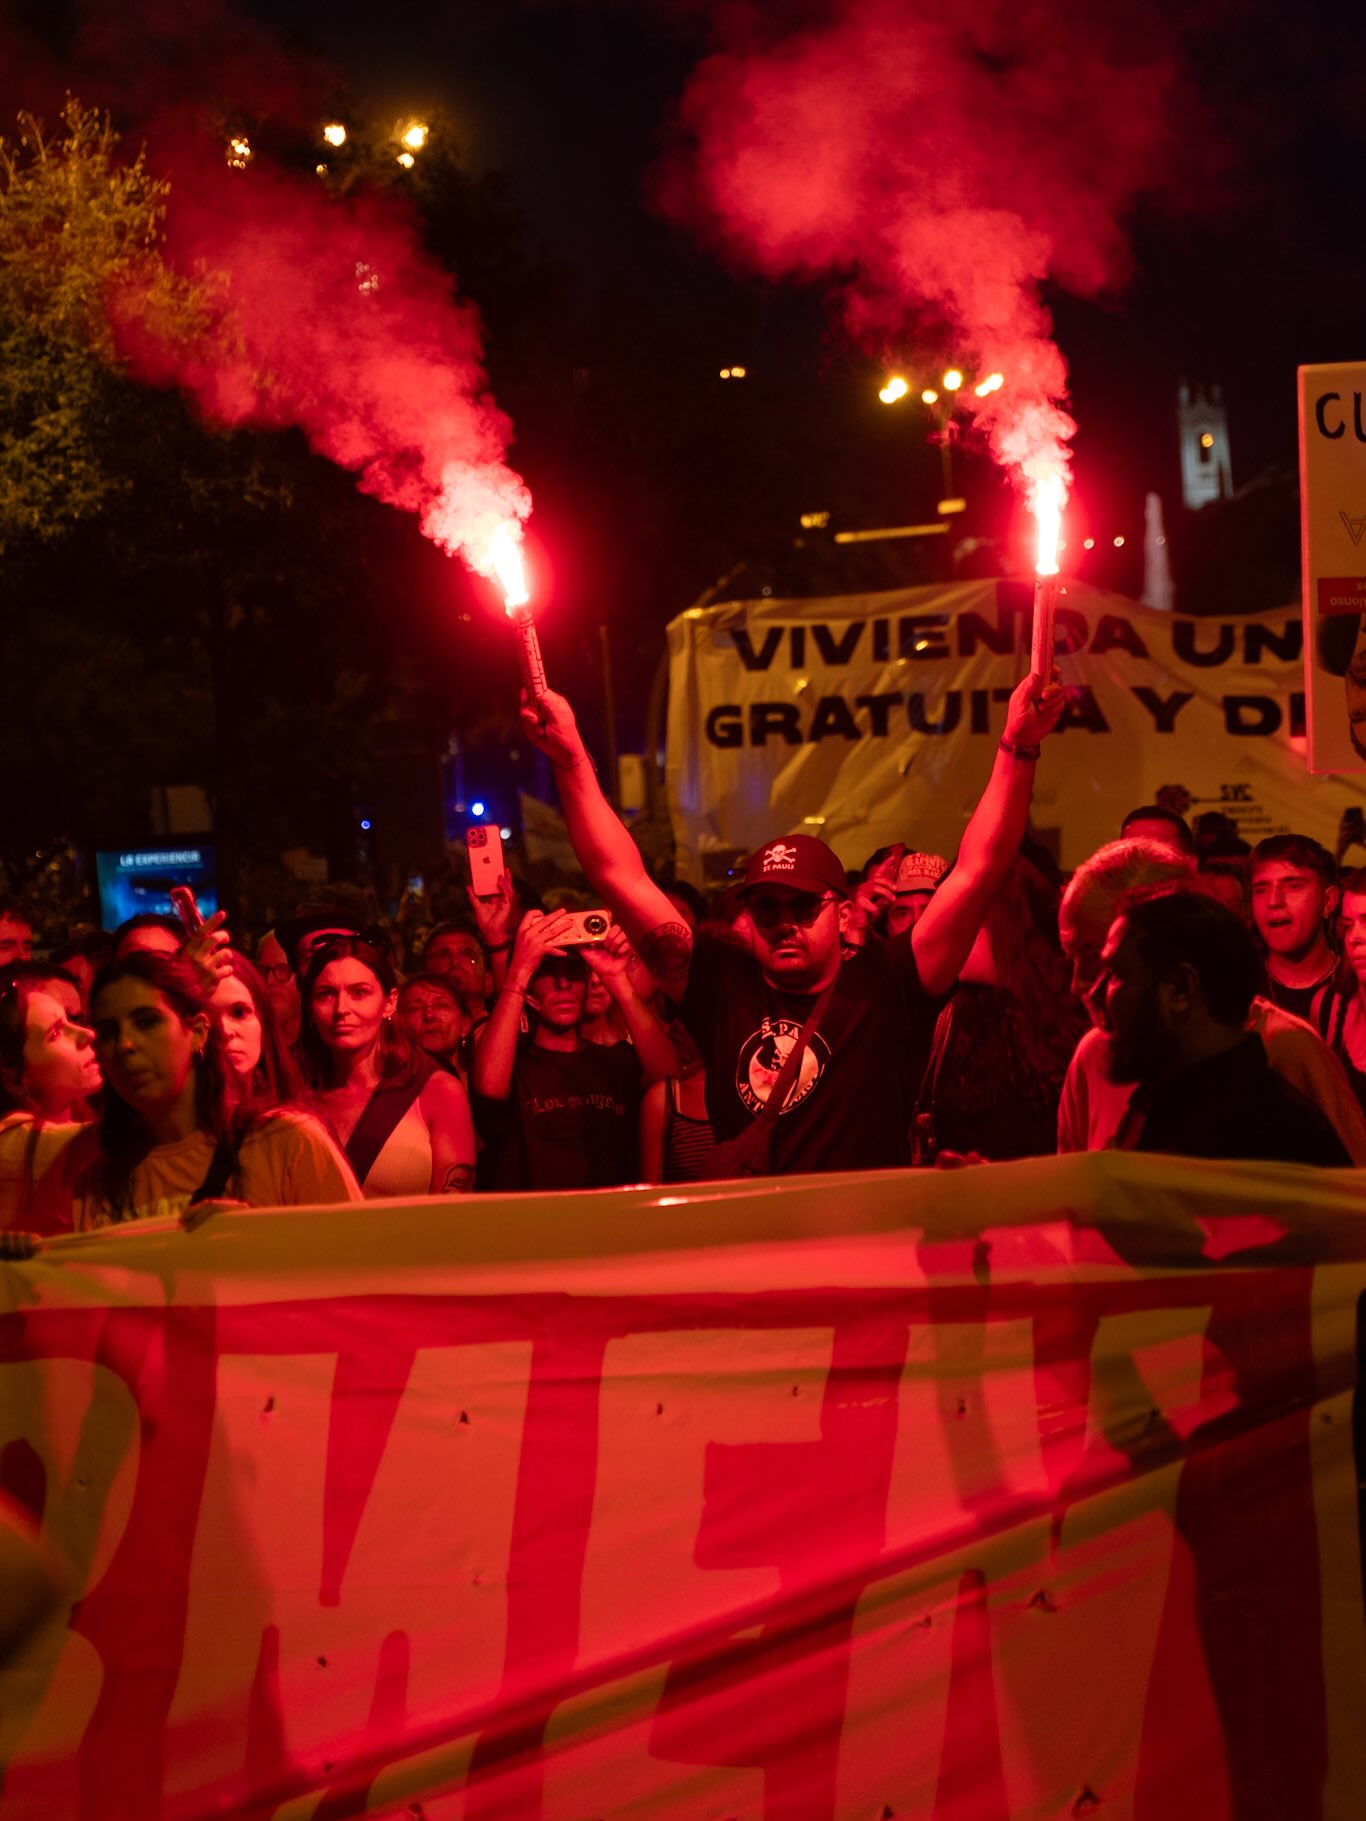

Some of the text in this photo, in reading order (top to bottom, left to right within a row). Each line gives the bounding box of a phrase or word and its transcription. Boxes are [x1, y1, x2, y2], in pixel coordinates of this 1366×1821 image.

[1330, 597, 1366, 609] lonso
[729, 609, 1150, 672] VIVIENDA
[1129, 686, 1196, 735] Y
[772, 863, 795, 871] PAULI
